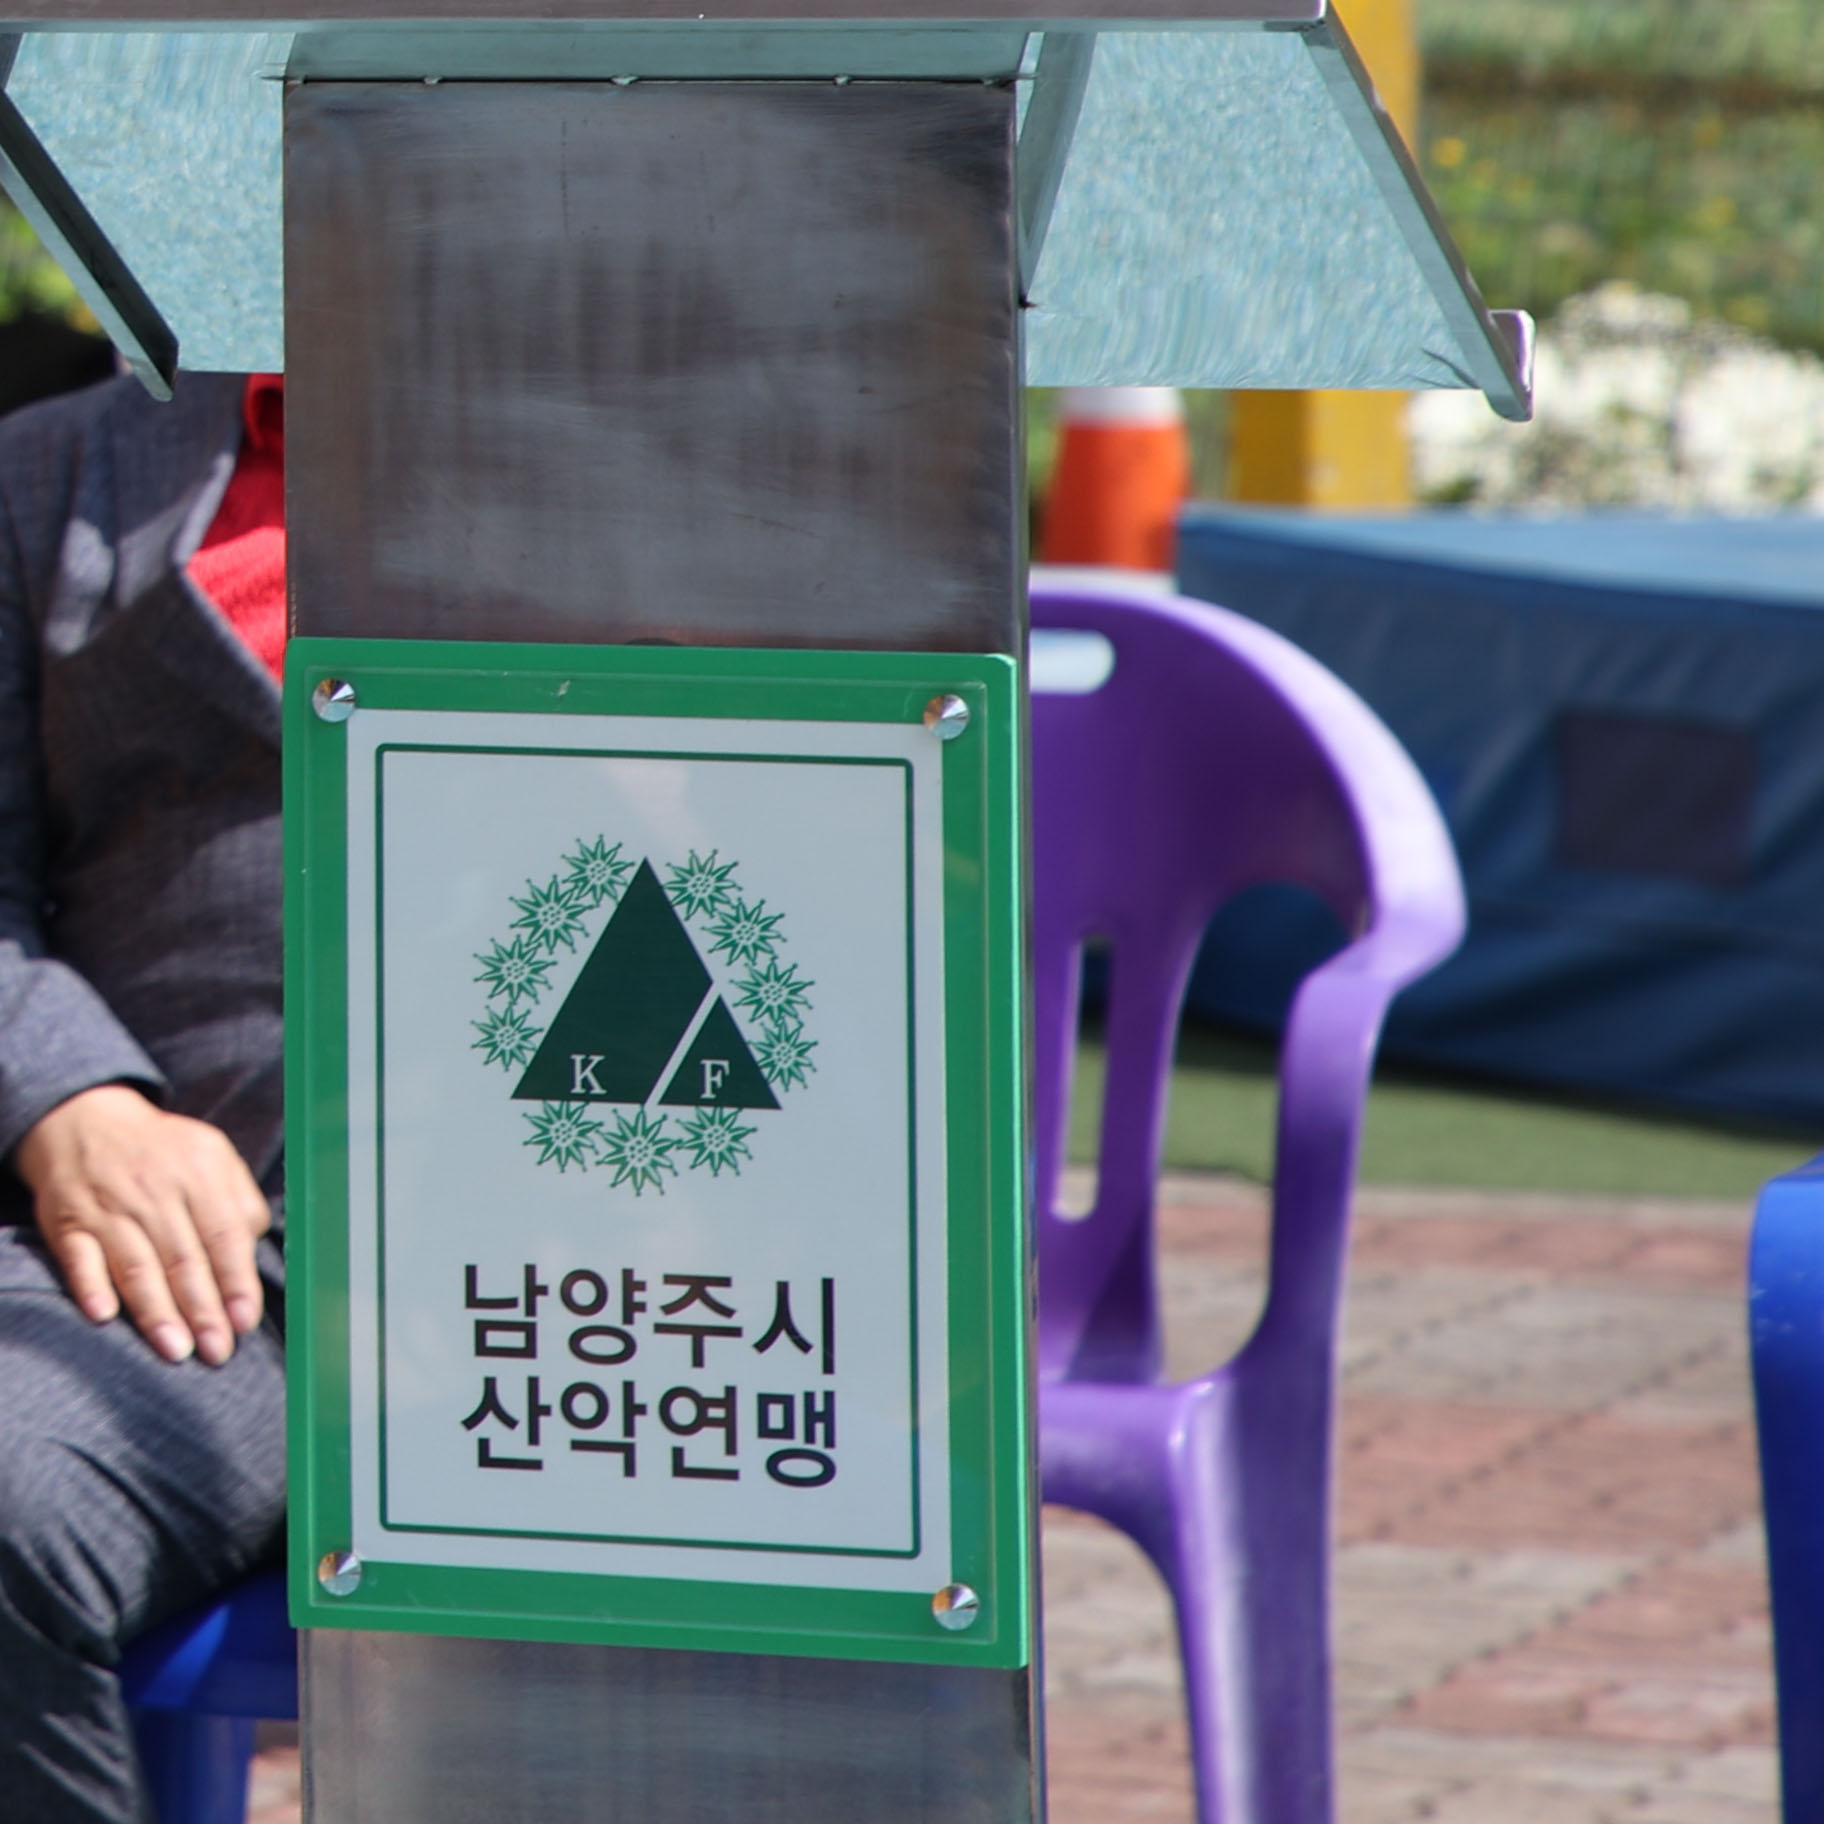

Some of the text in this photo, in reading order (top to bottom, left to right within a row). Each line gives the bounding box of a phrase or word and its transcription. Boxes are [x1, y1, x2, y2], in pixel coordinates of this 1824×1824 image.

[570, 1053, 731, 1101] K F
[463, 1263, 836, 1377] 남양주시
[459, 1375, 838, 1489] 산악연맹
